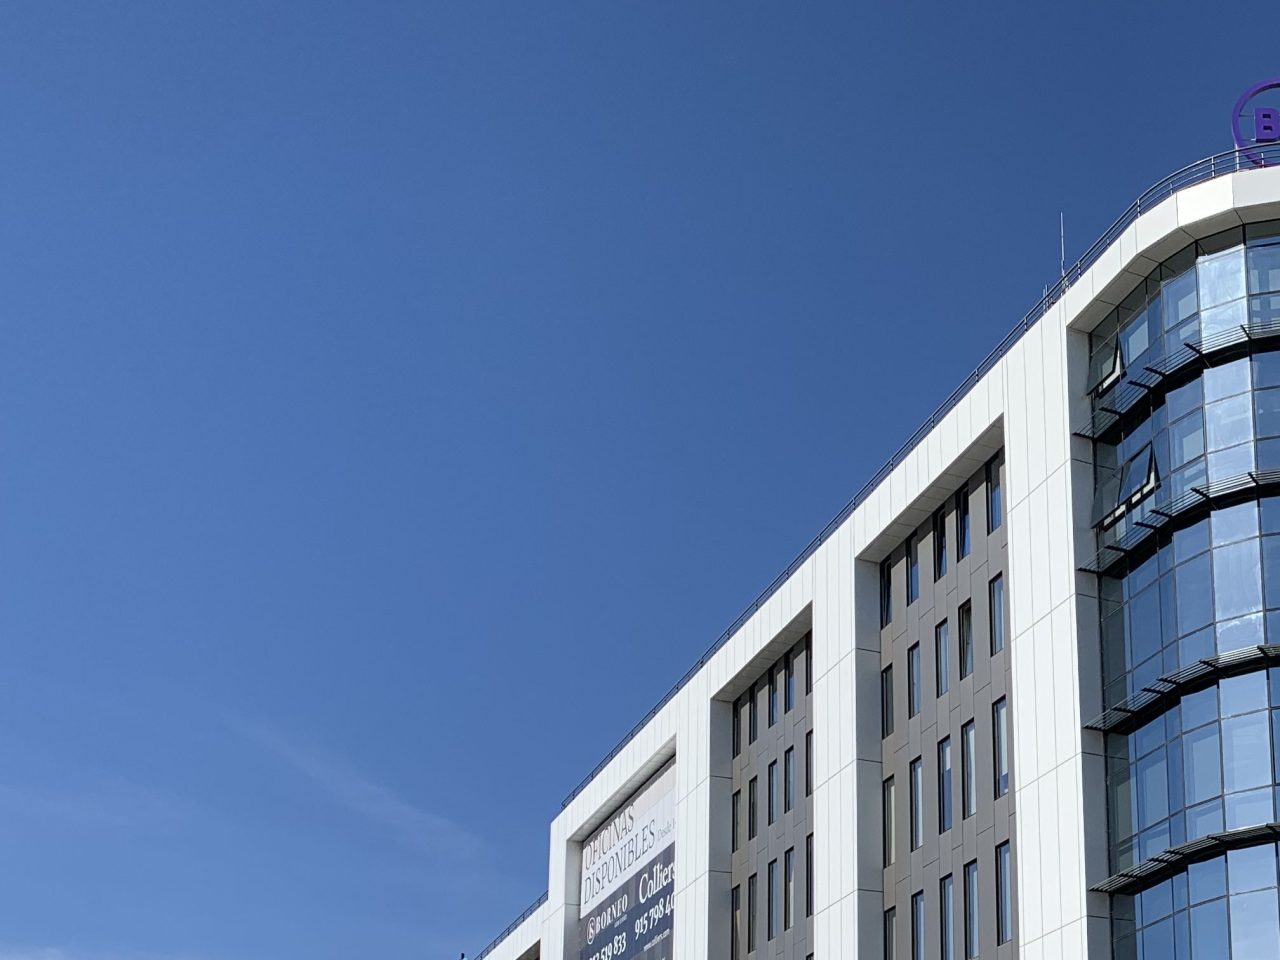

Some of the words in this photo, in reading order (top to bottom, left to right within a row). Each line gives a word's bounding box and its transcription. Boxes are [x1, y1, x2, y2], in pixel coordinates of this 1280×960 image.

[584, 804, 634, 870] OFICINAS
[584, 819, 655, 905] DISPONIBLES
[595, 894, 628, 934] BORNEO
[634, 913, 648, 940] 915
[649, 898, 664, 929] 798
[613, 932, 626, 955] 833
